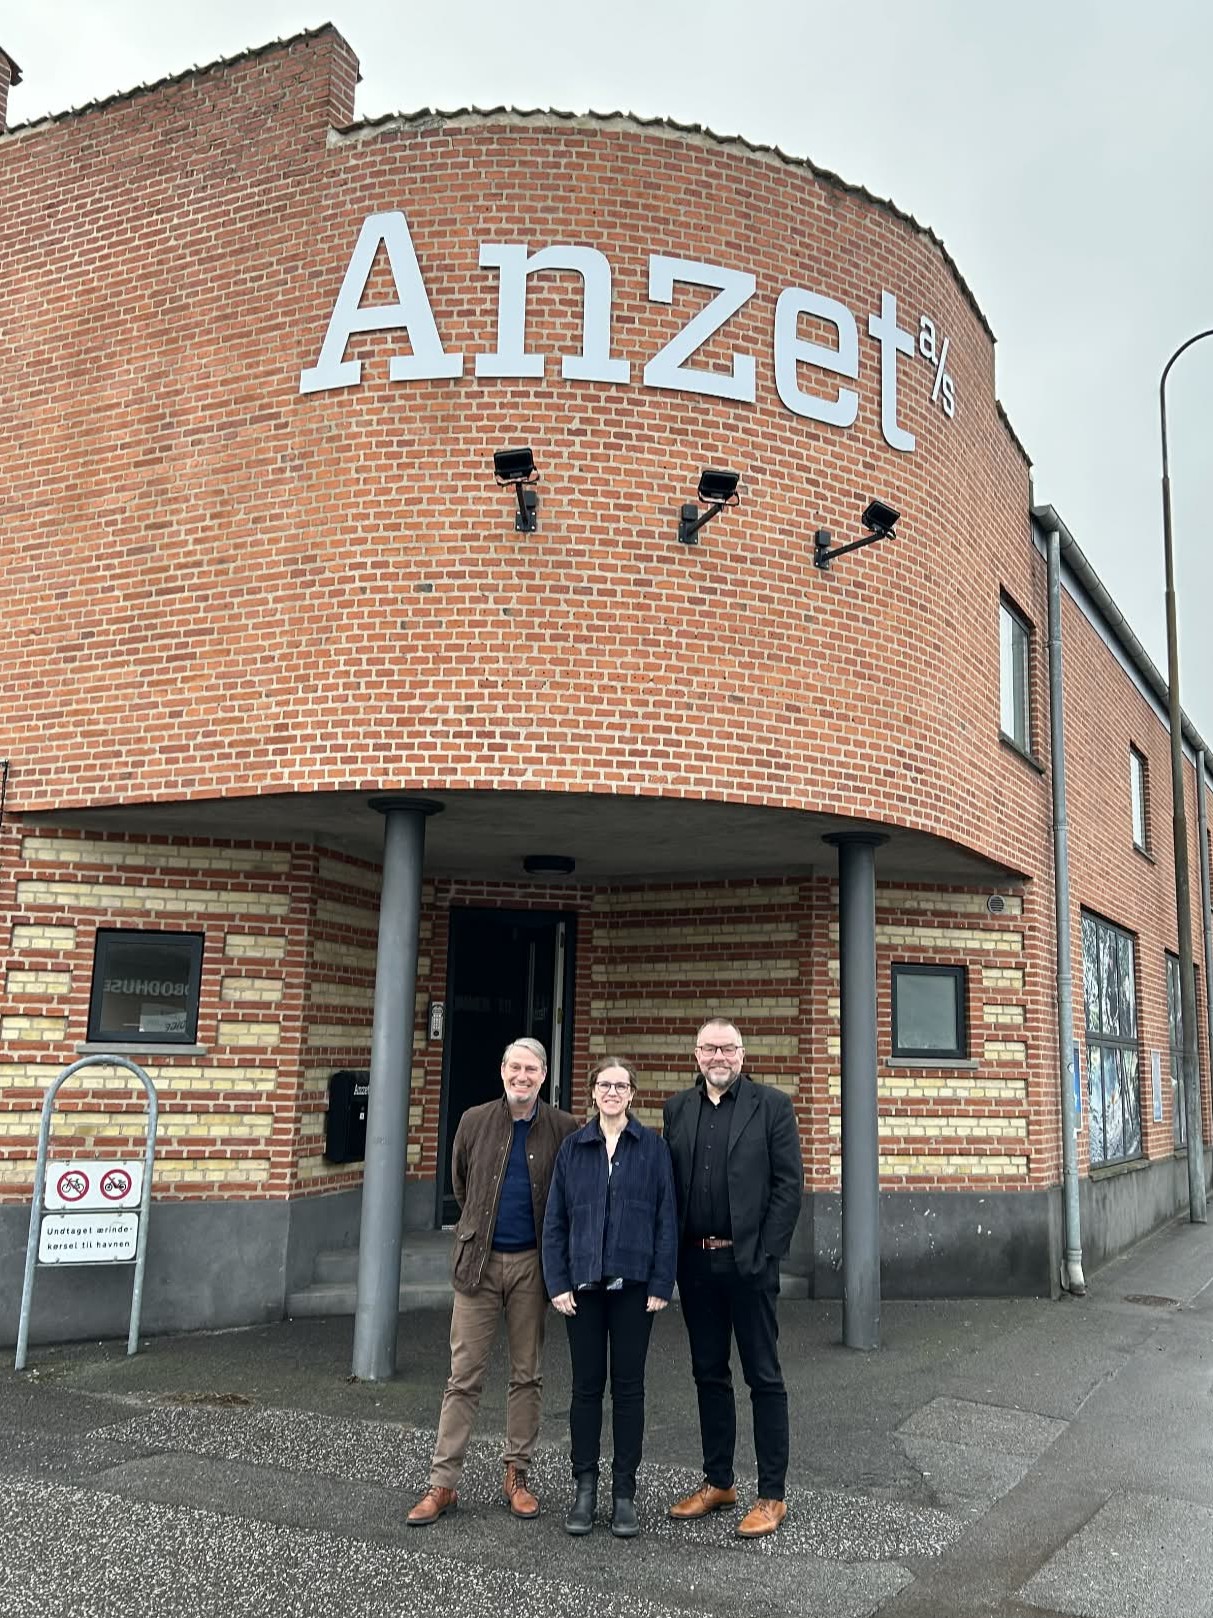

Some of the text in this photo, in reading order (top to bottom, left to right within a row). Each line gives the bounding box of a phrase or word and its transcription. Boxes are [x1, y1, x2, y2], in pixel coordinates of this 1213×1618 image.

[299, 211, 955, 452] Anzet a/s
[47, 1227, 92, 1236] Undtaget
[47, 1240, 130, 1250] kørsel til havnen
